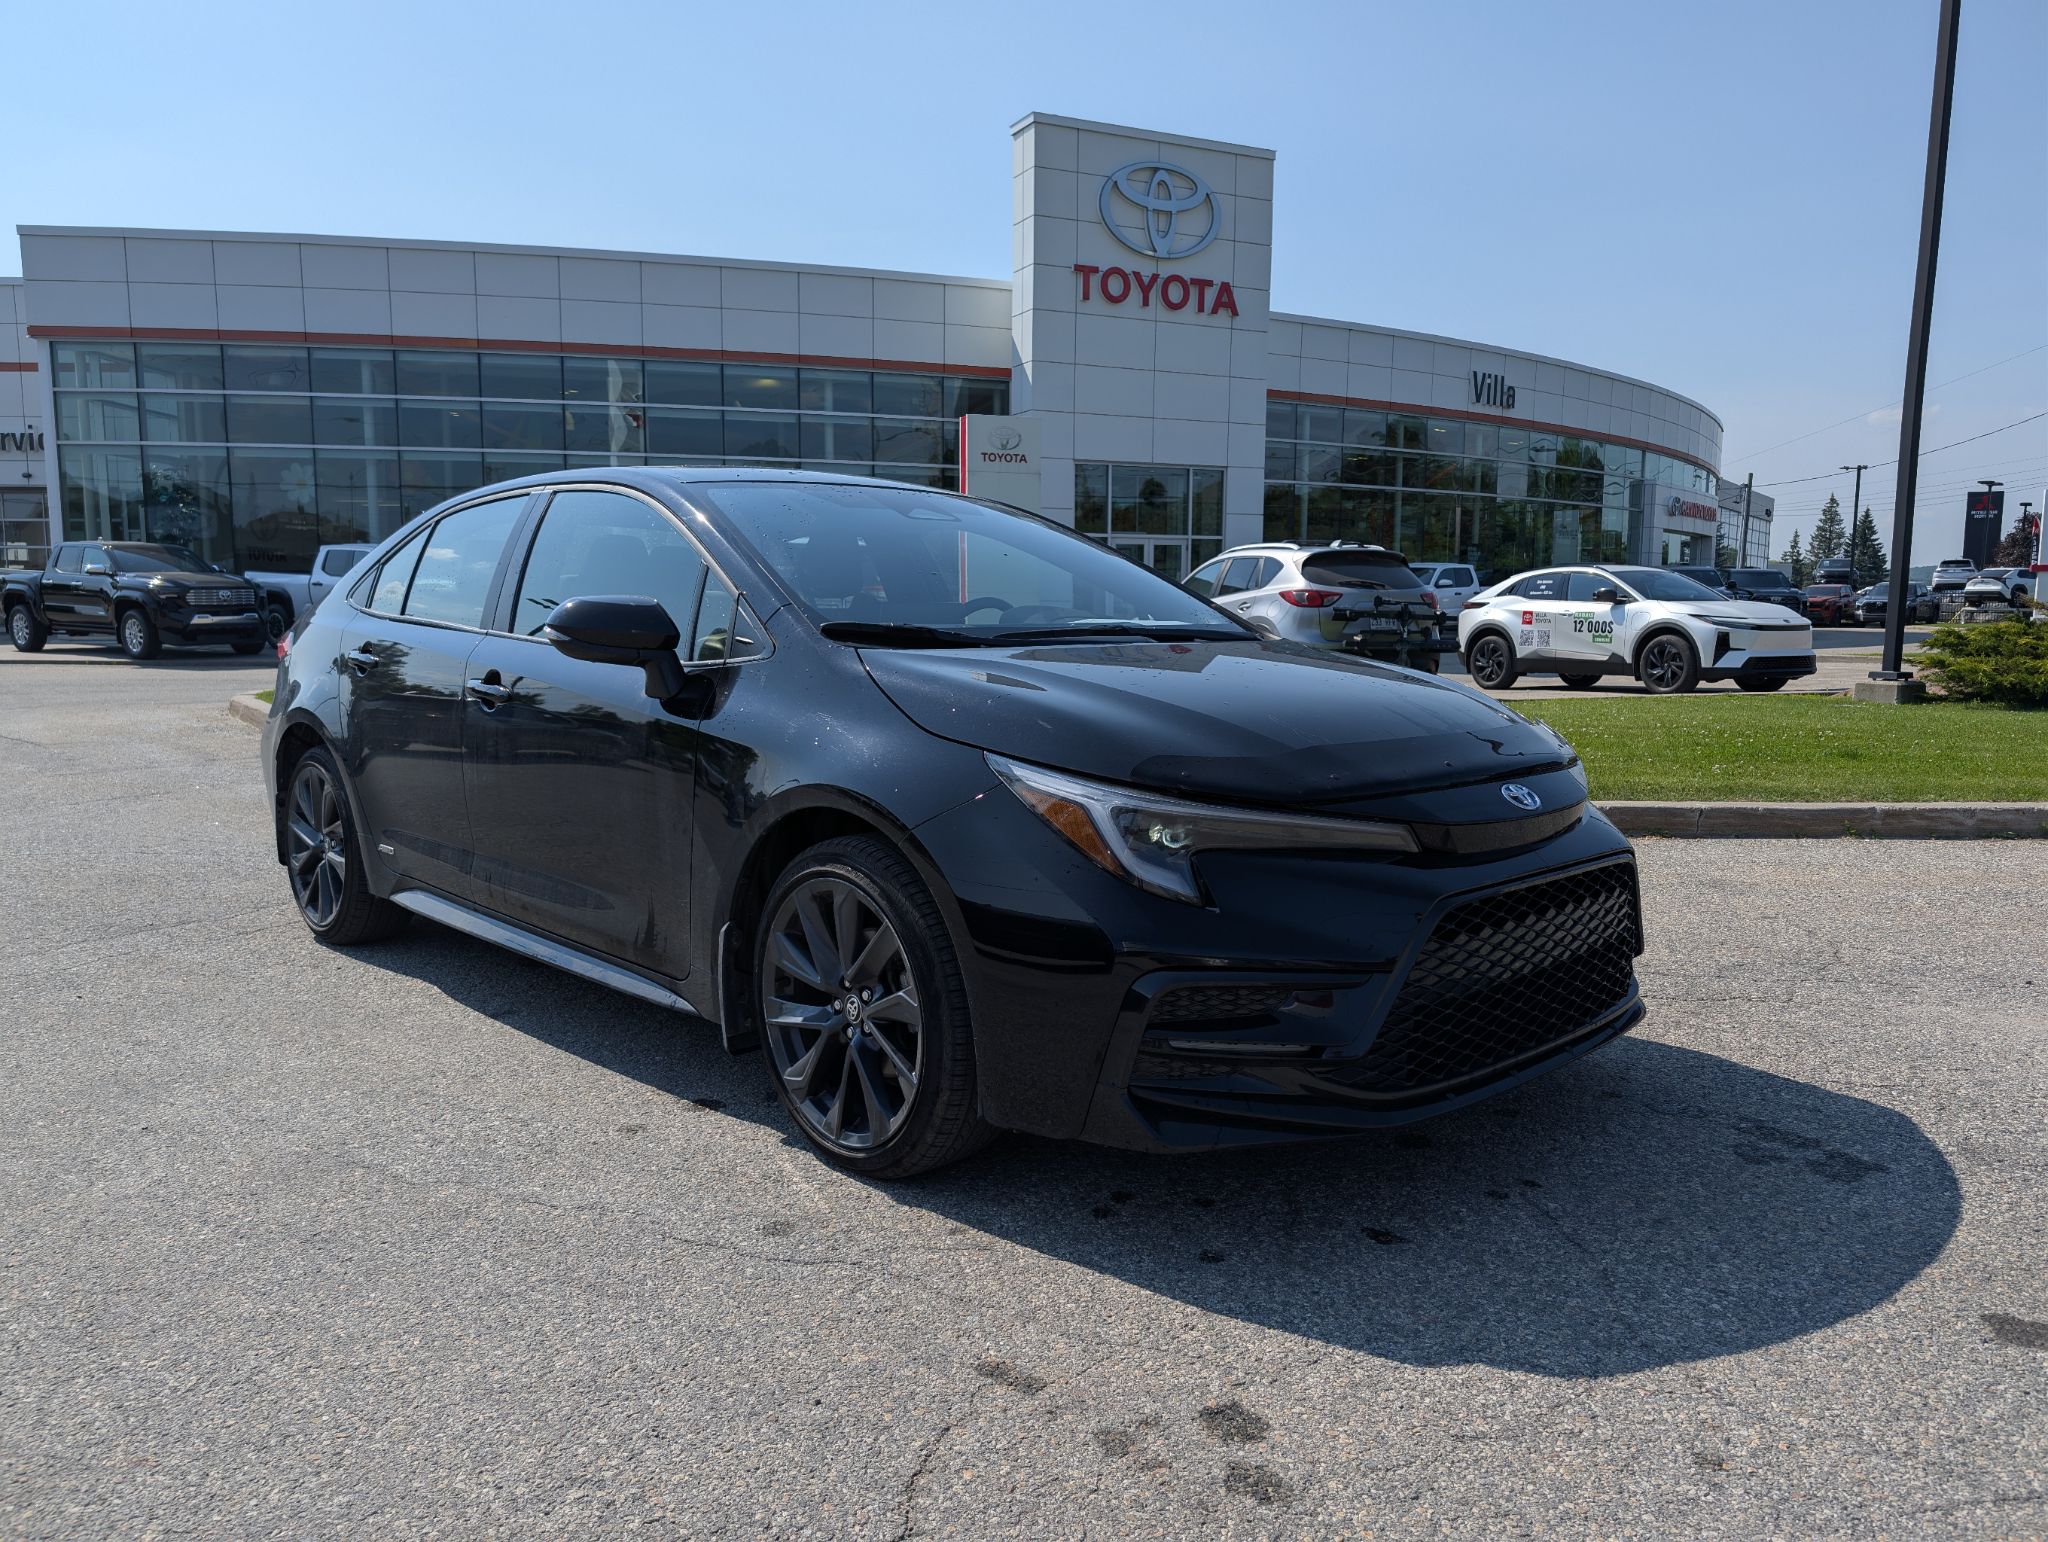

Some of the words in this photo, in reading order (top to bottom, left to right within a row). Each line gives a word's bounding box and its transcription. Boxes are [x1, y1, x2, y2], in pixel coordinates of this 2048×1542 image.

[1074, 264, 1239, 316] TOYOTA
[1472, 371, 1516, 409] Villa
[981, 452, 1028, 463] TOYOTA
[1573, 619, 1584, 633] 12
